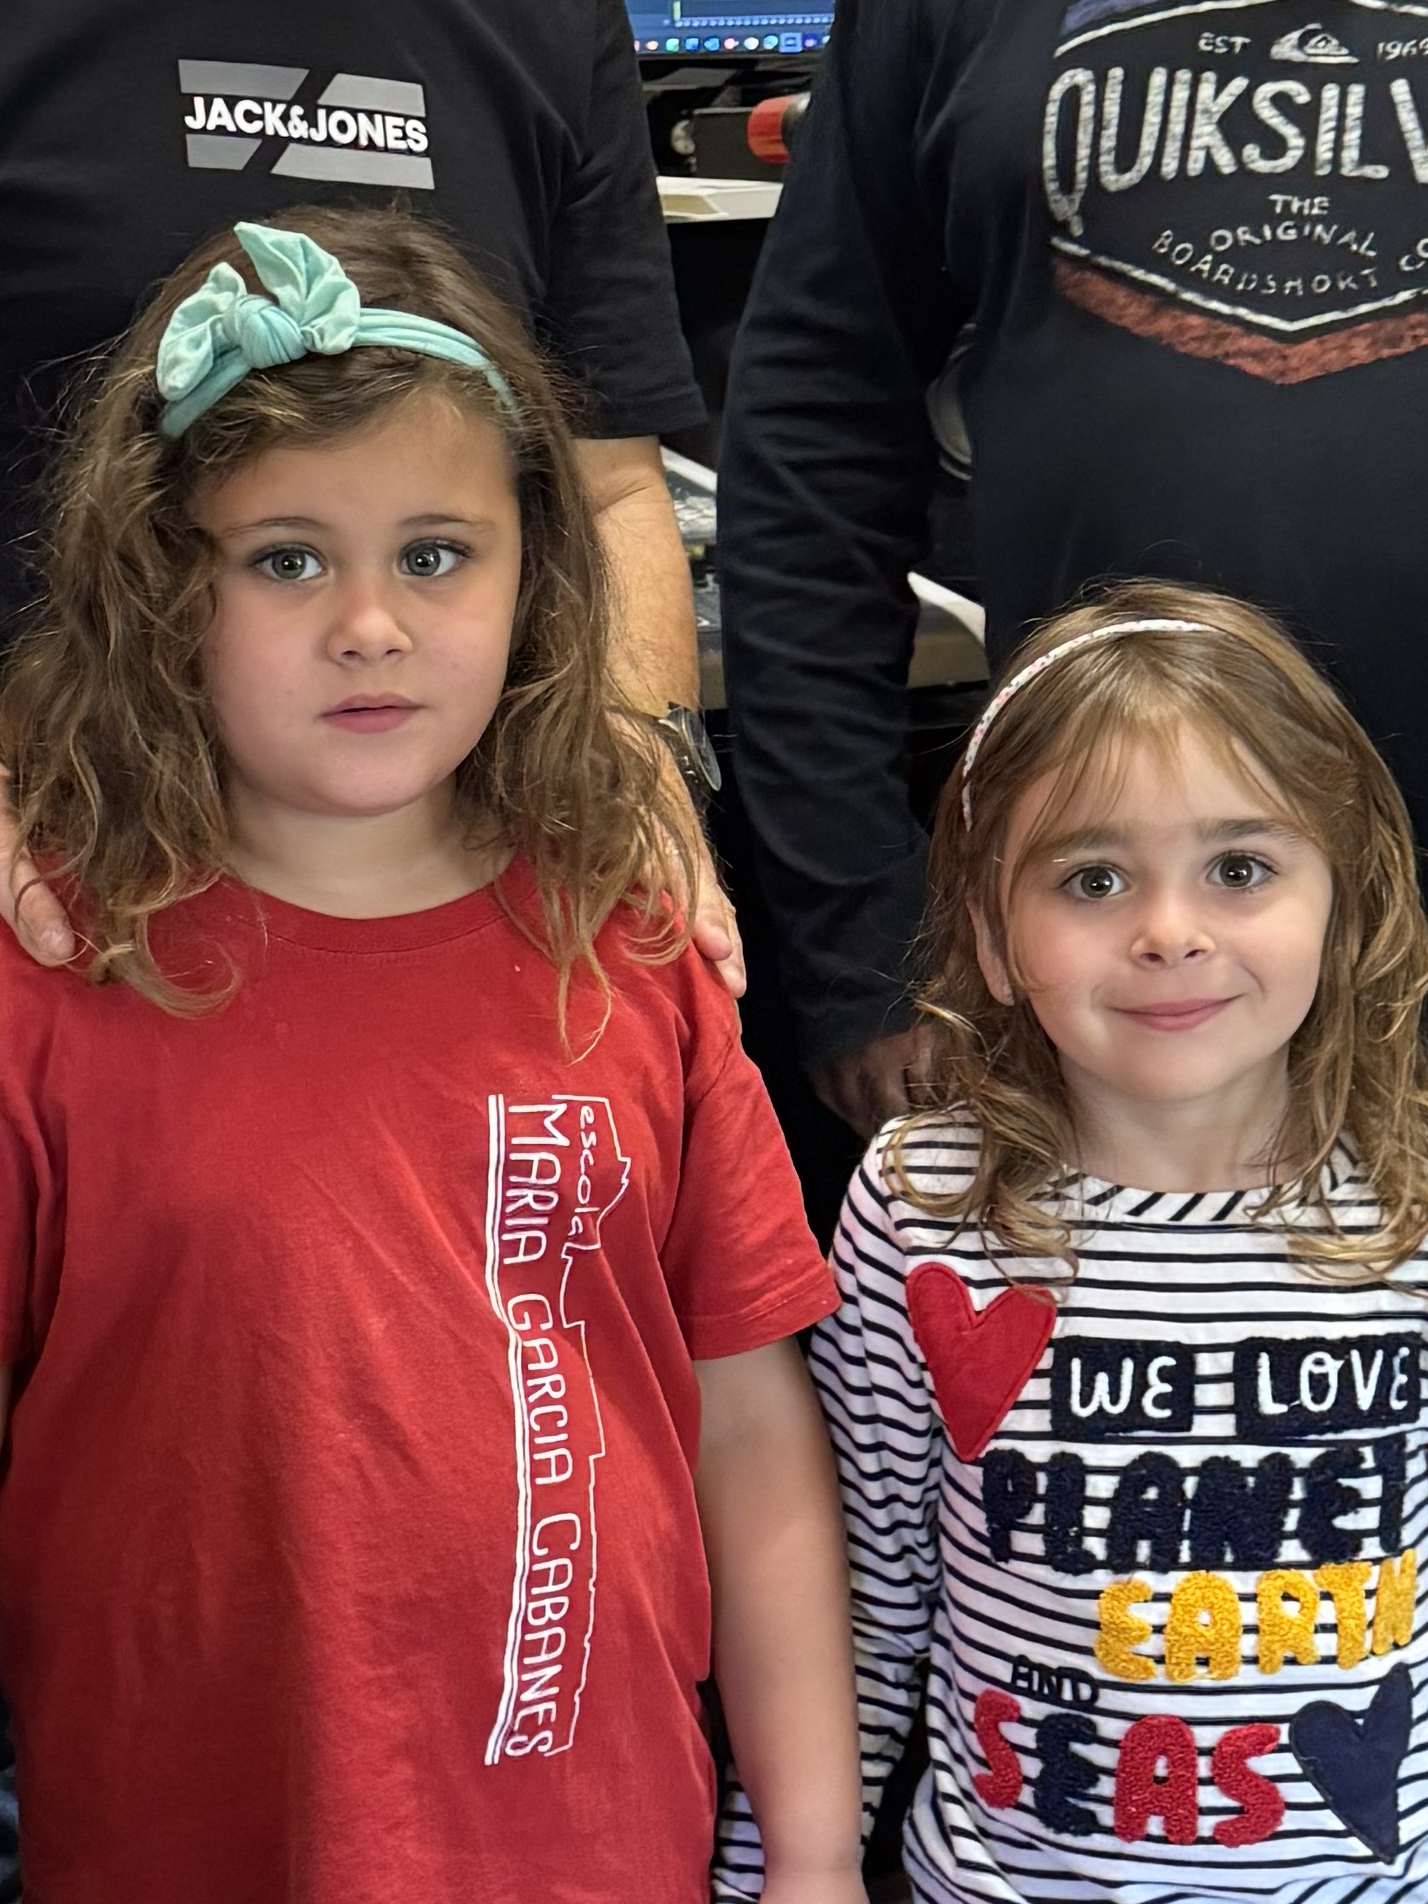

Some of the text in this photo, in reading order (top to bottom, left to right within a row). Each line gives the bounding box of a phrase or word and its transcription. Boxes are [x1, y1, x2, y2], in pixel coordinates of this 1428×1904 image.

[1198, 32, 1251, 54] EST
[183, 95, 429, 153] JACK&JONES
[1207, 220, 1378, 260] ORIGINAL
[1268, 194, 1331, 217] THE
[1151, 228, 1379, 297] BOARDSHORT
[567, 1104, 600, 1237] escola
[1069, 1345, 1413, 1420] WE LOVE
[502, 1100, 582, 1758] MARIA GARCIA CABANES
[980, 1434, 1409, 1576] PLANET
[1093, 1547, 1420, 1681] EARTH
[973, 1688, 1286, 1848] SEAS
